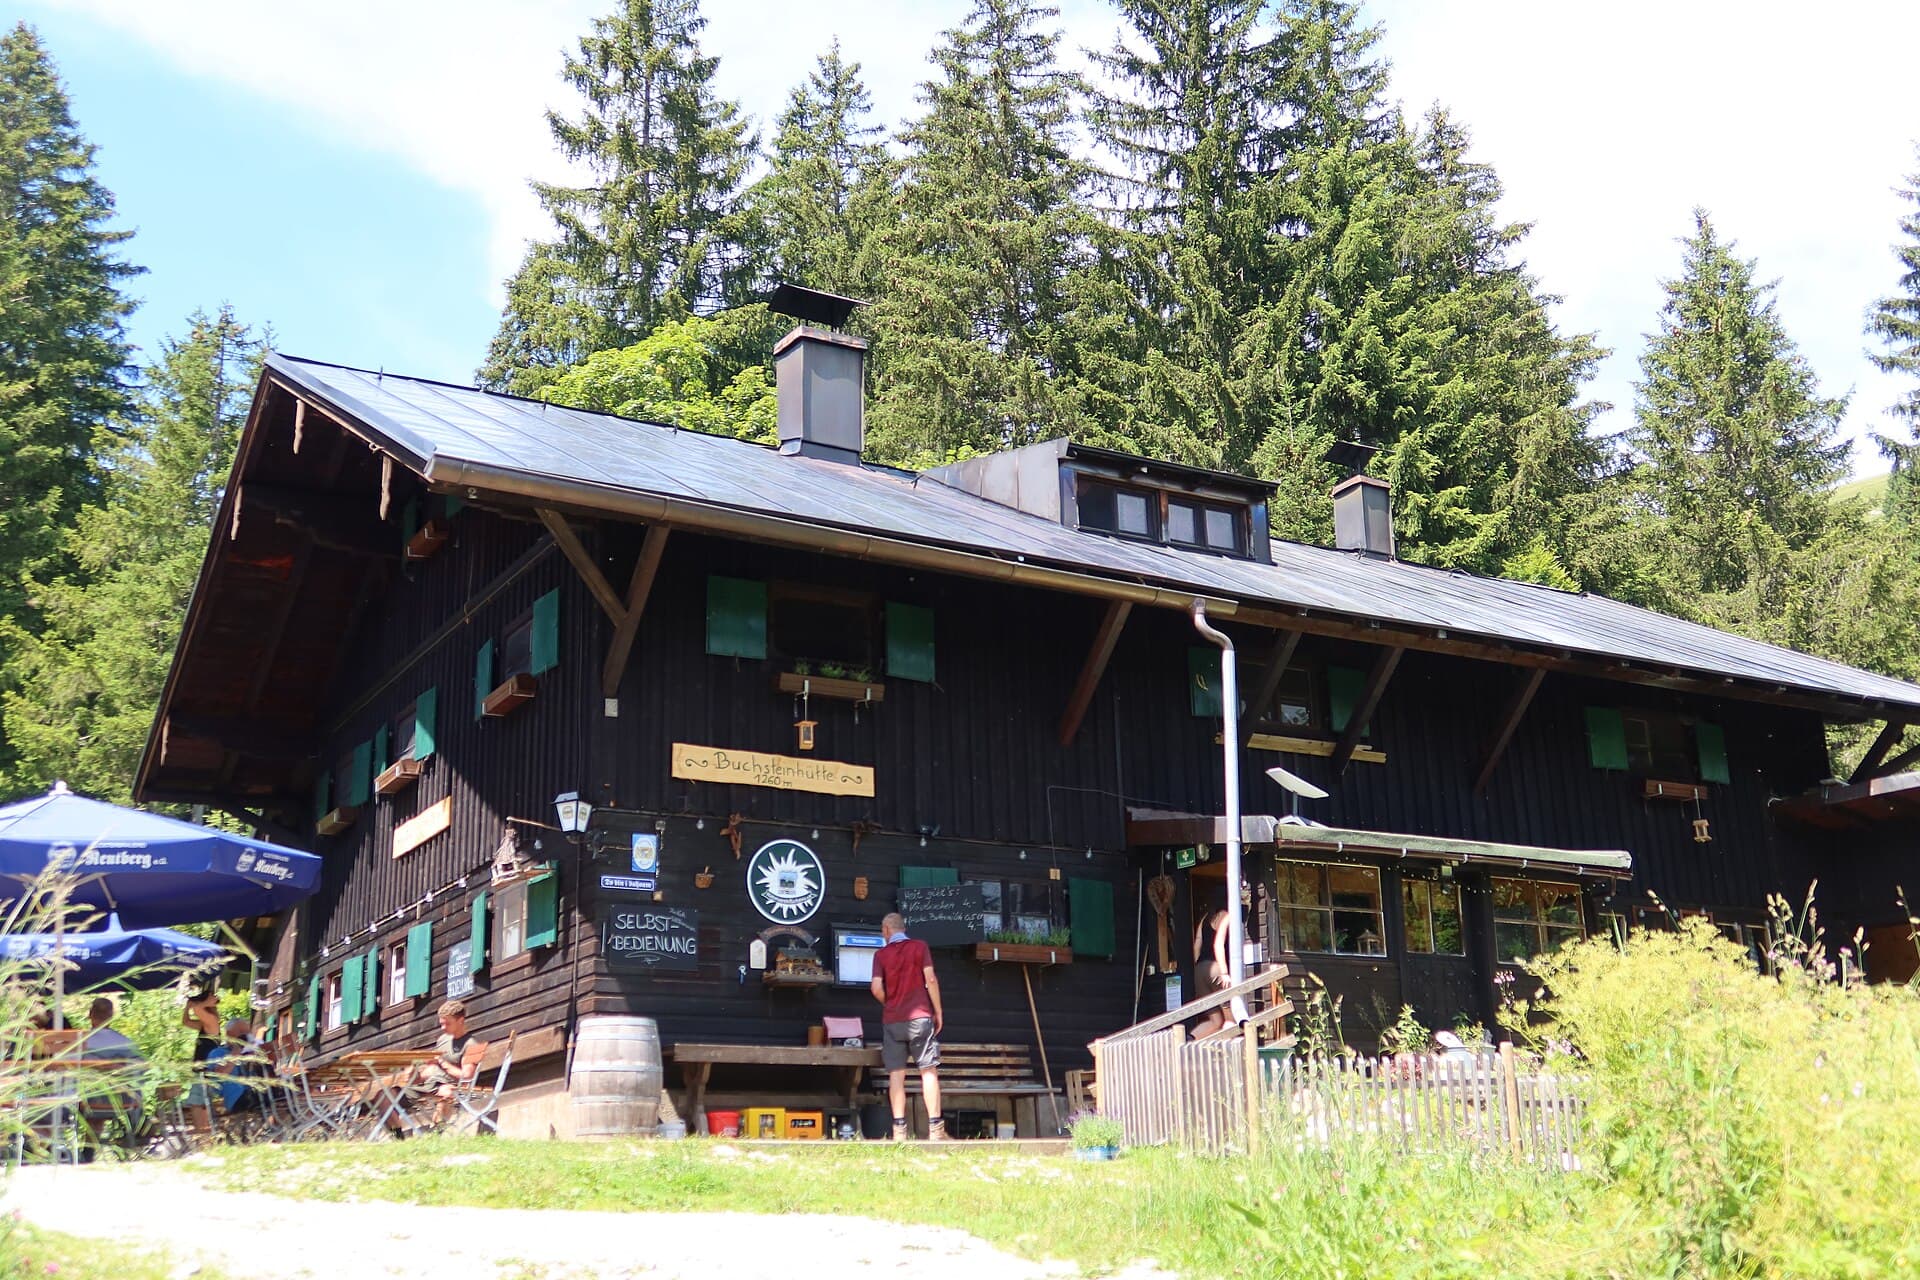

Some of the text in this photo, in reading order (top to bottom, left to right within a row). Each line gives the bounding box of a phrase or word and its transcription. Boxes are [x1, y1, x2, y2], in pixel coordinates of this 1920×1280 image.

[754, 774, 781, 786] 1260
[614, 913, 680, 932] SELBST-
[611, 935, 697, 955] BEDIENUNG
